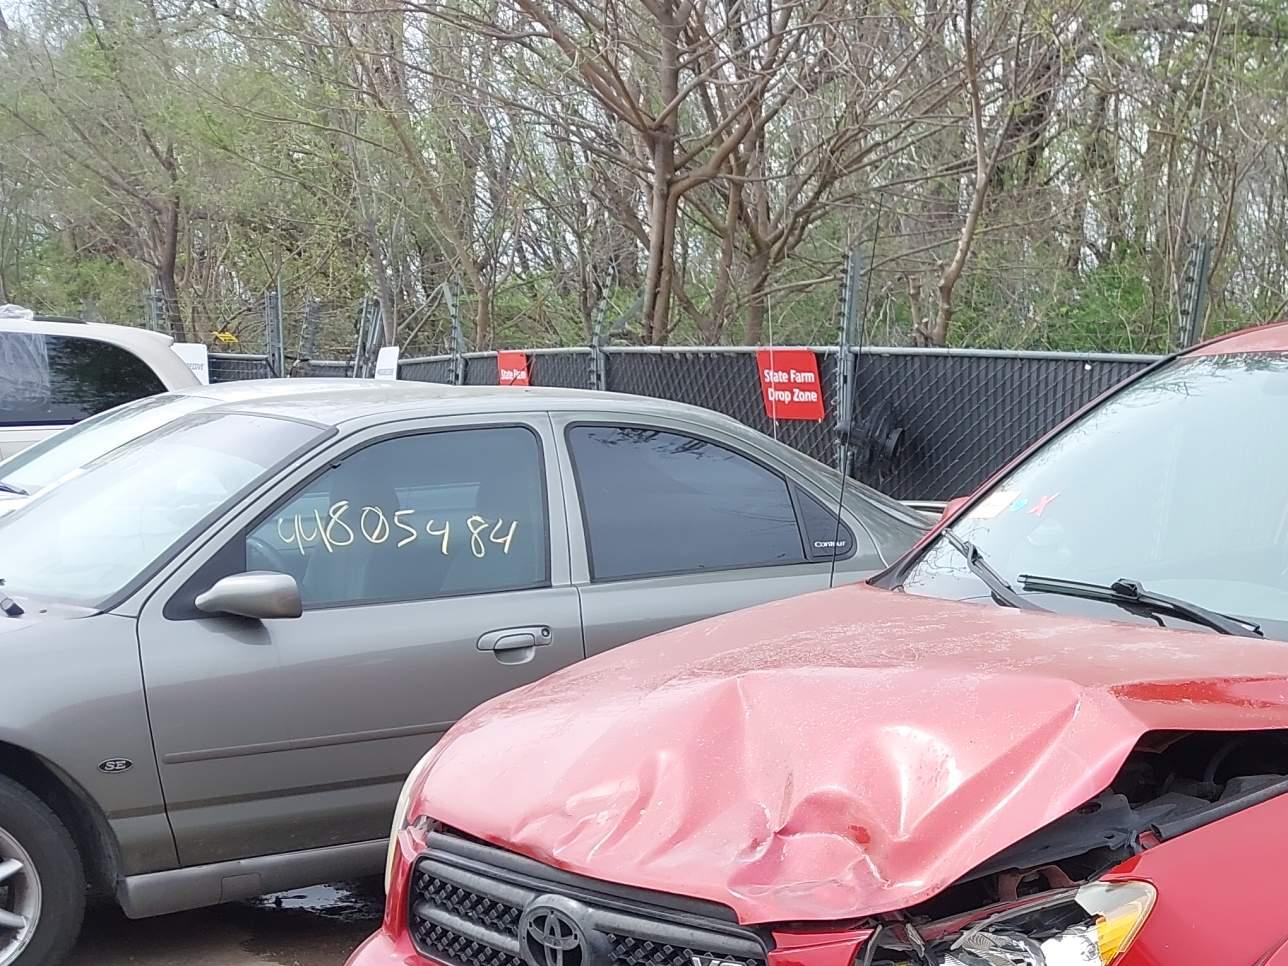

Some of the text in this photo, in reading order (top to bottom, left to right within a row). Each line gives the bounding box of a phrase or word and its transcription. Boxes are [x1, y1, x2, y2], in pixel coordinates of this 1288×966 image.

[764, 369, 815, 383] State Farm
[768, 387, 818, 404] Drop Zone
[105, 760, 126, 770] SE
